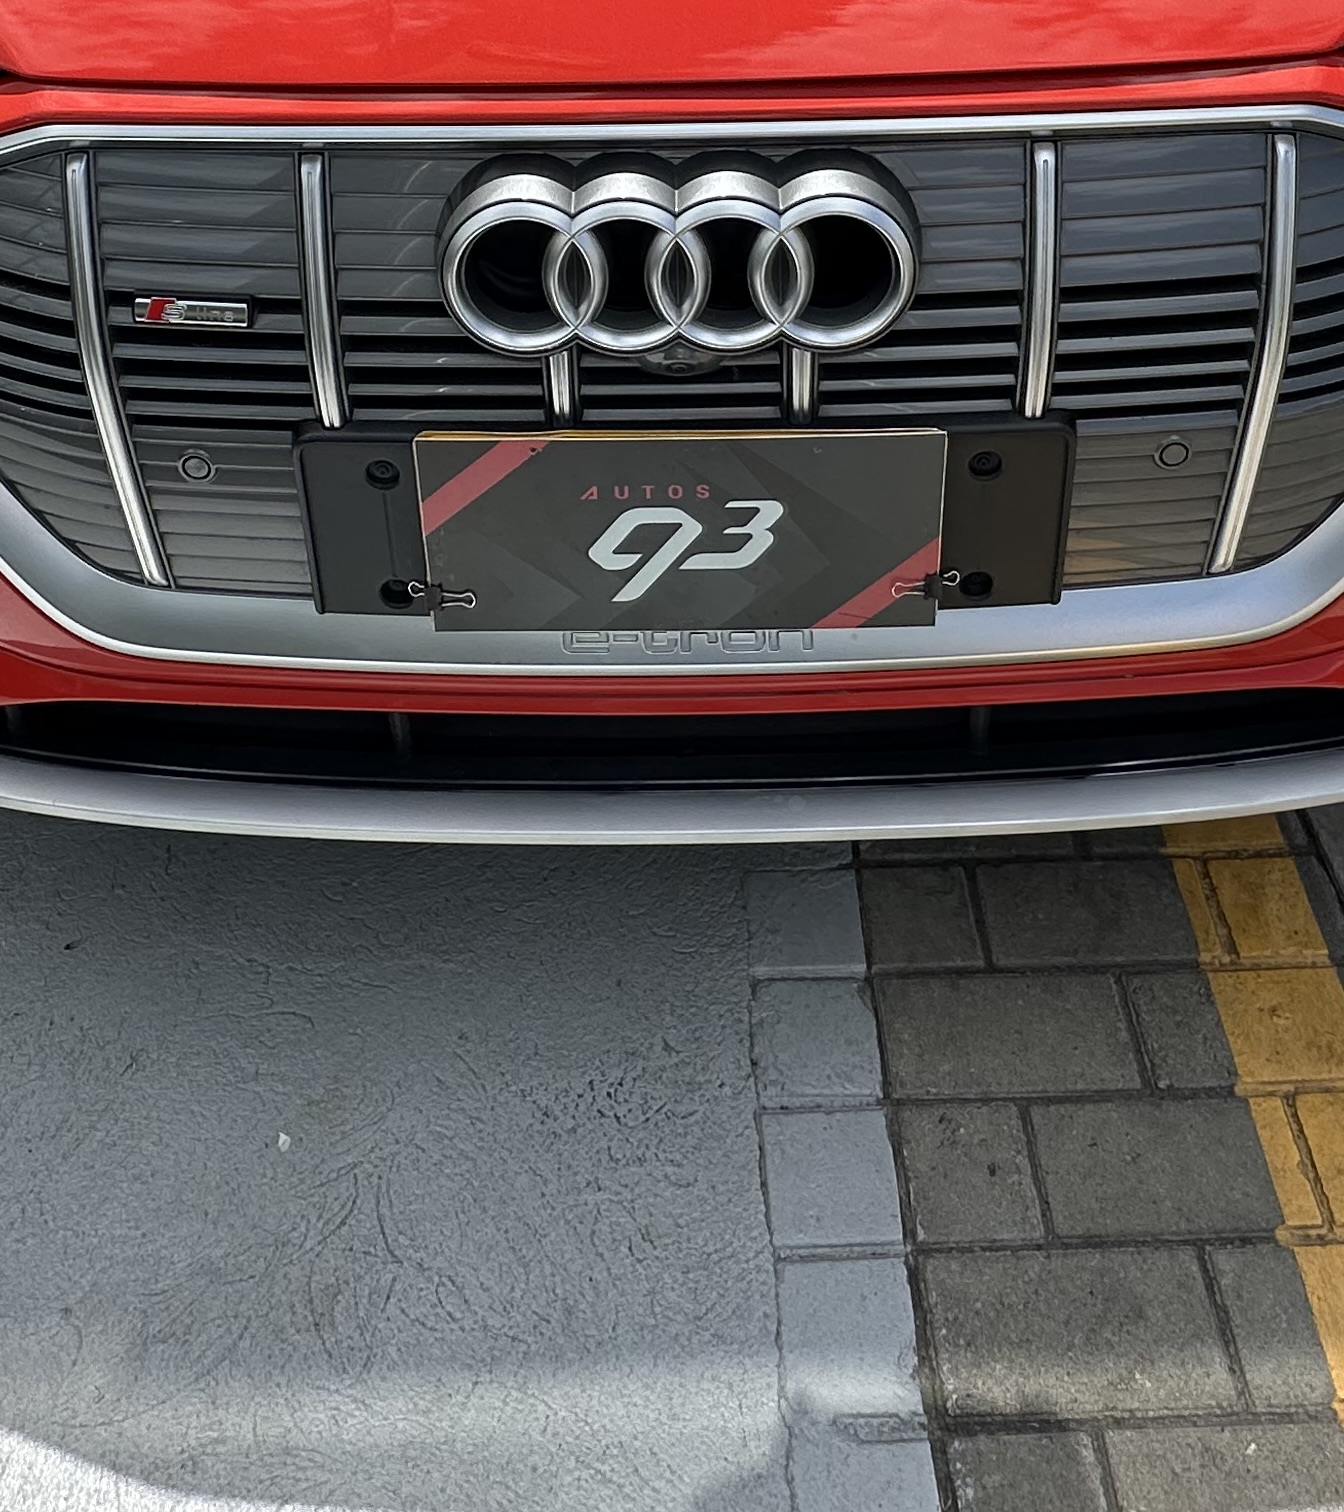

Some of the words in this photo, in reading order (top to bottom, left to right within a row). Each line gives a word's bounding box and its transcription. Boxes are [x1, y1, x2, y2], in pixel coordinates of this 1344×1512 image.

[579, 484, 711, 501] AUTOS
[587, 499, 785, 603] 93
[560, 629, 816, 656] e-tron
